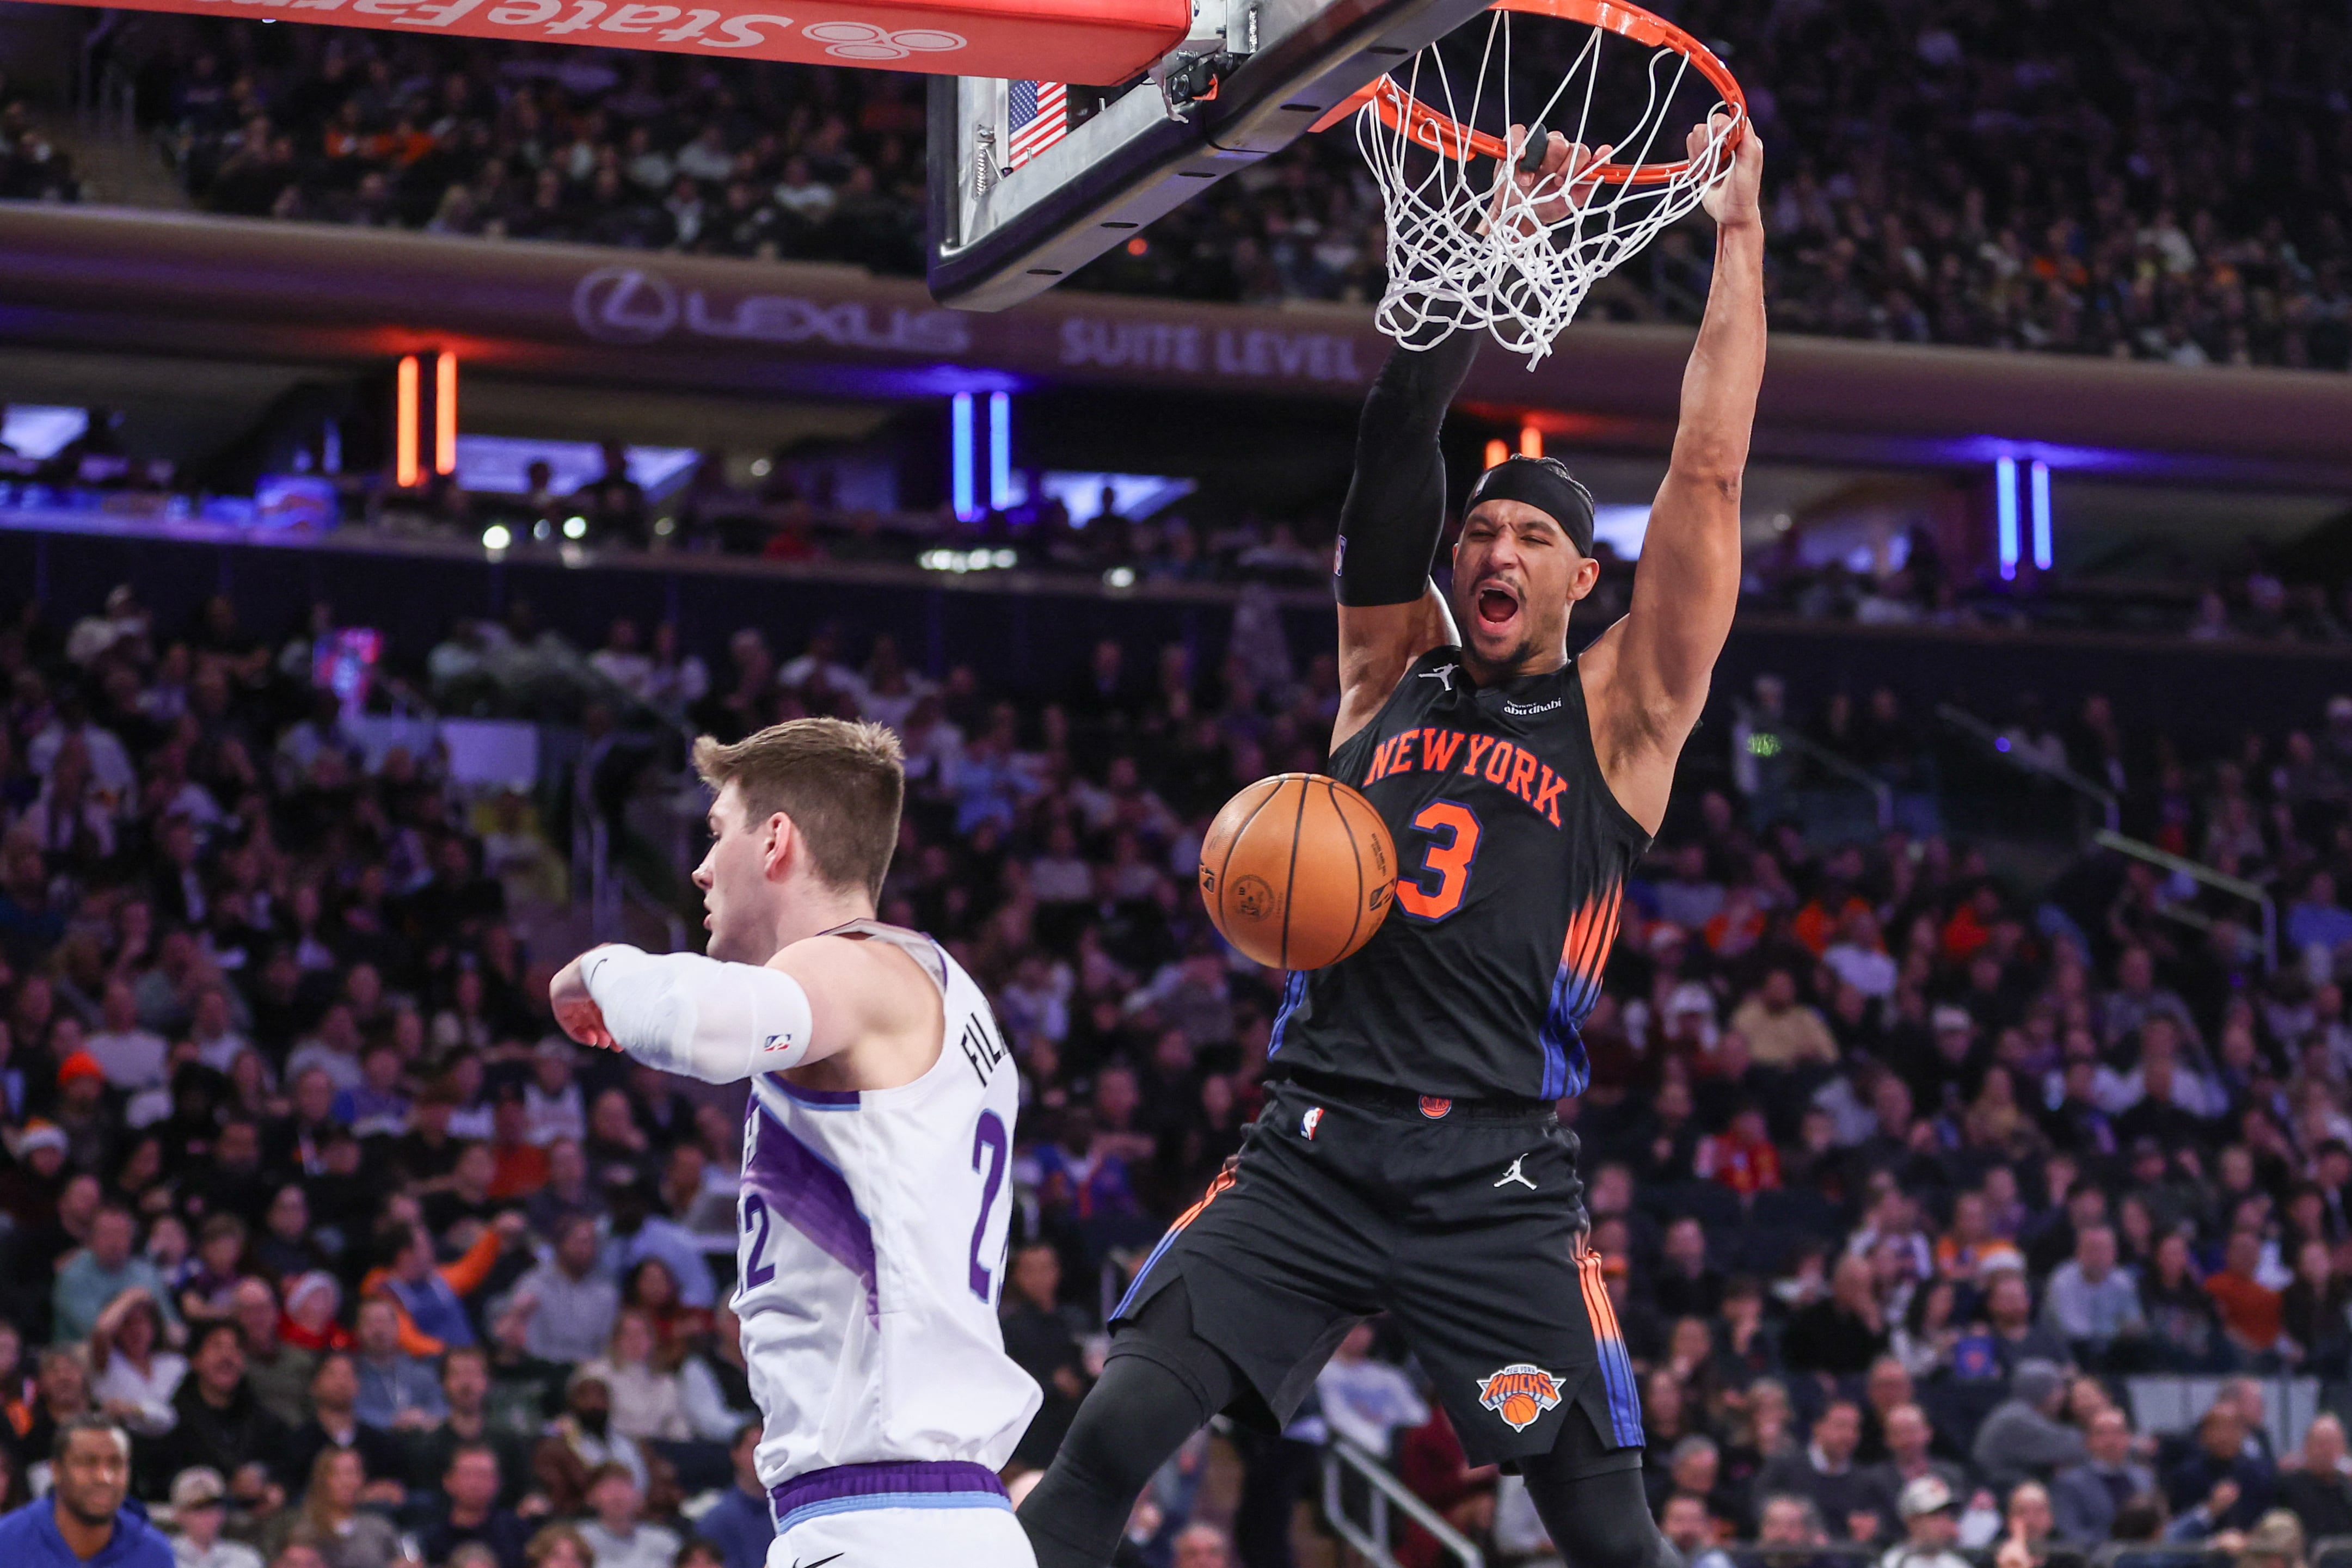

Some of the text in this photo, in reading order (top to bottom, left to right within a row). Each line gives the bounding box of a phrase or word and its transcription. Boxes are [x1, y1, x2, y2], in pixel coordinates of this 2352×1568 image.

[686, 291, 970, 354] LEXUS
[1061, 317, 1358, 380] SUITE LEVEL
[1504, 697, 1562, 715] abu dhabi
[1395, 798, 1483, 923] 3
[969, 1108, 1010, 1305] 2
[1482, 1373, 1558, 1401] KNICKS
